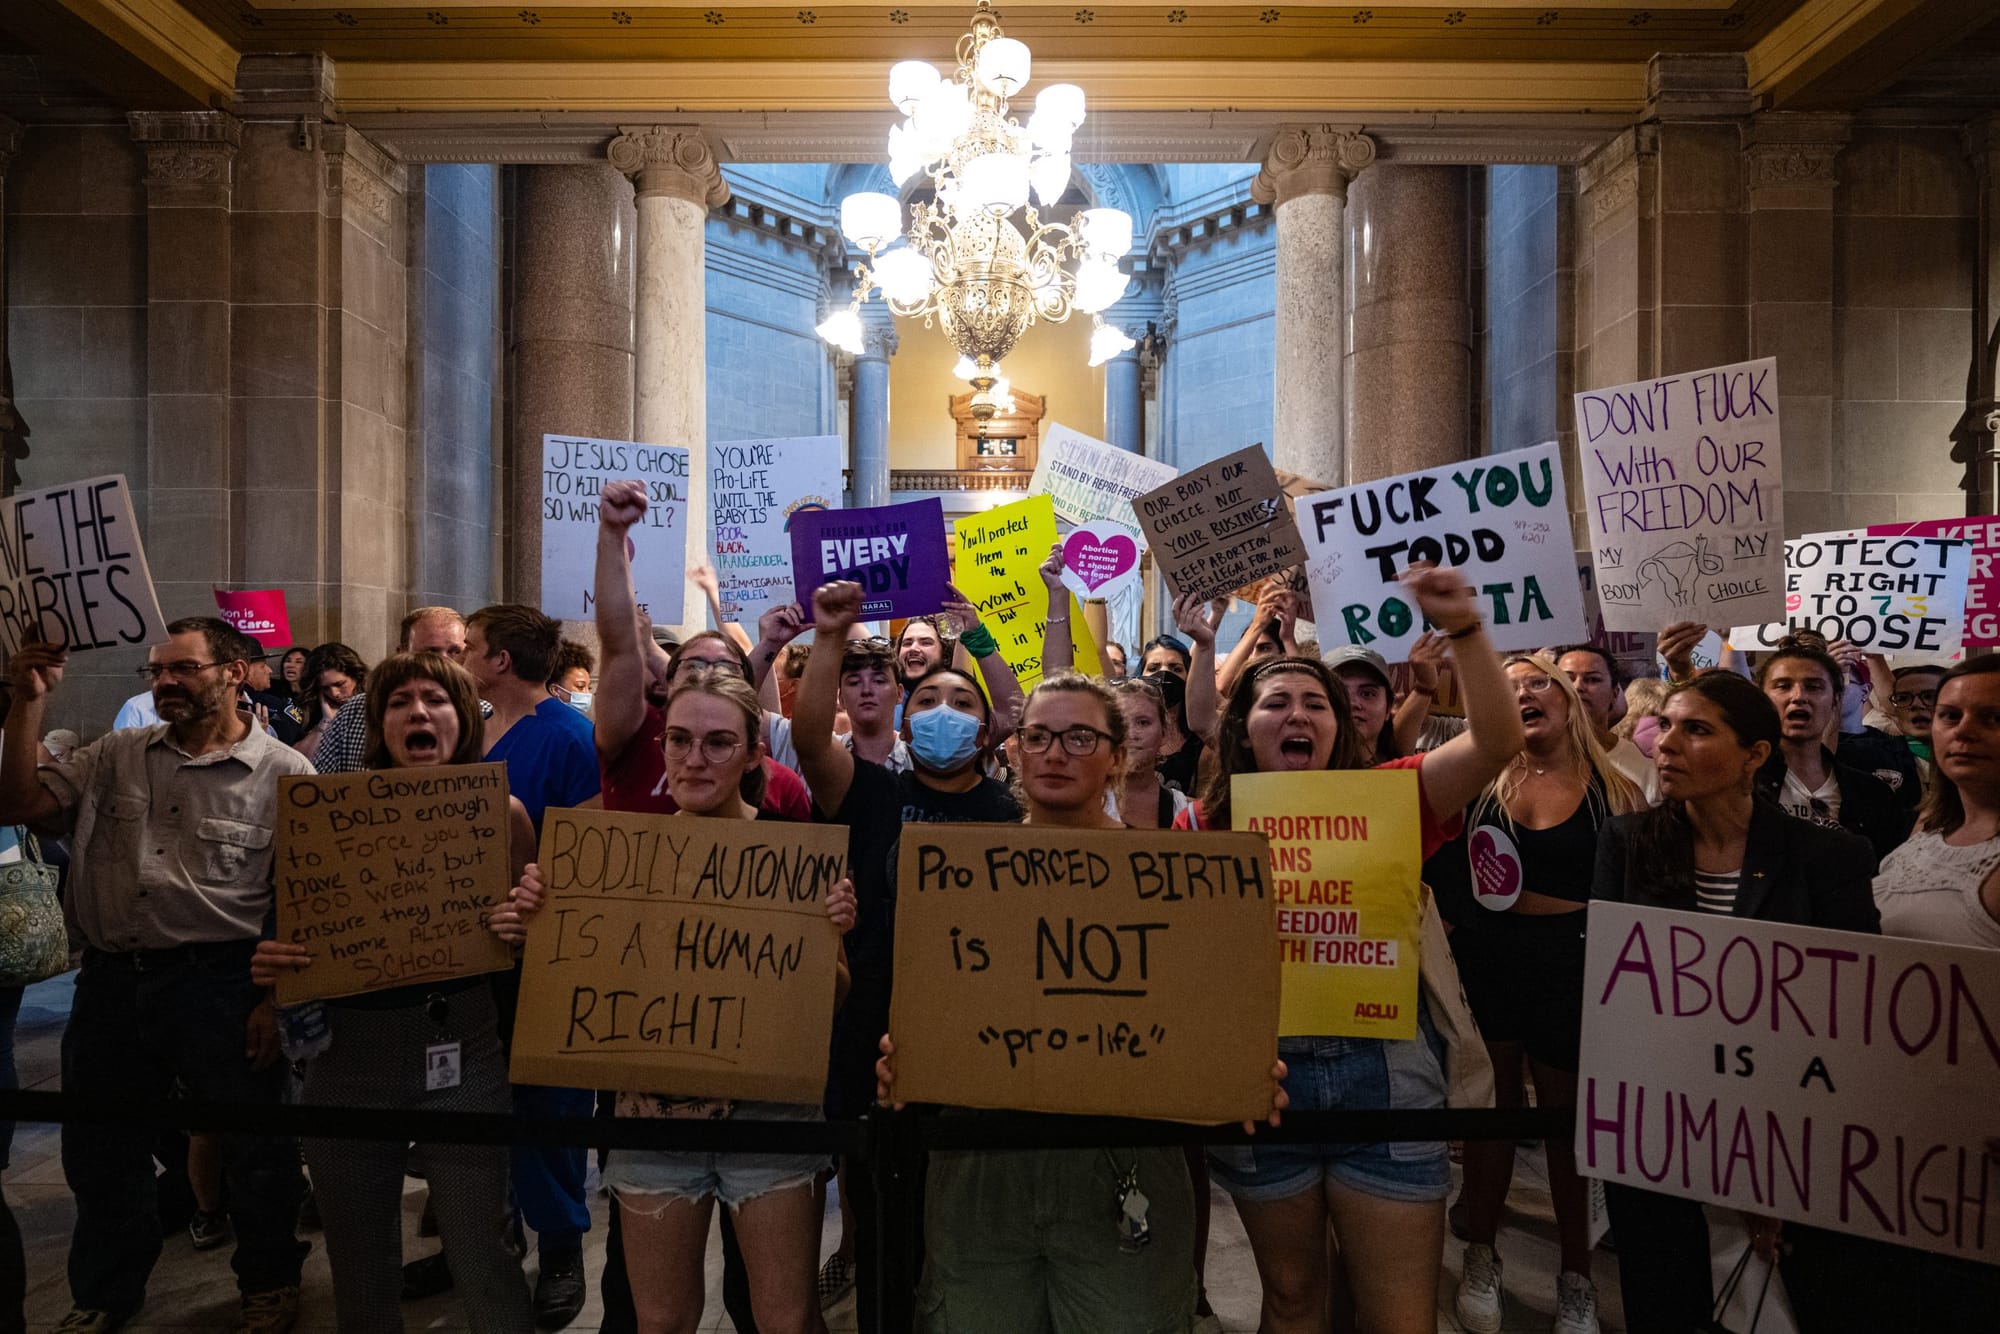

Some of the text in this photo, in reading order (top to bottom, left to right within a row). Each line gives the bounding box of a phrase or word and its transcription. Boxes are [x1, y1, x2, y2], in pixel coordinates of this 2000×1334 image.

[1582, 368, 1774, 443] DON'T FUCK
[550, 439, 689, 477] JESUS CHOSE
[1696, 435, 1767, 476] OUR
[543, 470, 571, 494] TO
[1050, 459, 1081, 481] STAND
[1079, 471, 1093, 485] BY
[1092, 476, 1117, 495] REPRO
[1143, 496, 1175, 517] OUR
[1222, 462, 1248, 482] OUR
[544, 498, 563, 520] SO
[714, 491, 753, 509] UNTIL
[754, 490, 778, 508] THE
[1067, 503, 1079, 516] BY
[1216, 487, 1243, 508] NOT
[1312, 457, 1552, 544] FUCK YOU
[1597, 478, 1763, 534] FREEDOM
[46, 480, 131, 568] THE
[714, 507, 769, 526] BABY IS
[988, 515, 1029, 543] protect
[820, 533, 909, 575] EVERY
[1081, 544, 1118, 555] Abortion
[1164, 530, 1209, 554] YOUR
[1734, 532, 1769, 556] MY
[1785, 539, 1963, 569] ROTECT
[975, 545, 1028, 567] them in
[1087, 562, 1116, 572] should
[1088, 554, 1119, 564] normal
[1170, 534, 1272, 586] KEEP ABORTION
[1250, 552, 1268, 568] FOR
[1365, 528, 1506, 583] TODD
[1600, 547, 1624, 564] MY
[989, 566, 1006, 577] the
[1078, 569, 1112, 580] be legal
[718, 579, 731, 590] AN
[1200, 575, 1248, 600] QUESTIONS
[1601, 582, 1642, 602] BODY
[1707, 577, 1767, 600] CHOICE
[1825, 573, 1946, 596] RIGHT
[244, 608, 254, 618] is
[861, 602, 890, 612] NARAL
[998, 608, 1017, 625] but
[1811, 594, 1857, 616] TO
[1871, 595, 1892, 616] 7
[1902, 596, 1928, 618] 3
[237, 619, 275, 631] Care.
[1013, 633, 1029, 645] in
[289, 769, 500, 809] Our Government
[290, 796, 489, 836] is BOLD enough
[1247, 816, 1368, 841] ABORTION
[288, 846, 322, 869] to
[422, 828, 459, 854] you
[468, 825, 496, 841] to
[550, 819, 691, 895] BODILY
[1269, 847, 1312, 872] ANS
[286, 873, 346, 900] have
[360, 868, 378, 885] a
[444, 850, 487, 872] but
[918, 845, 1264, 902] Pro FORCED BIRTH
[287, 876, 475, 921] TOO WEAK to
[291, 894, 500, 944] ensure they make
[330, 936, 389, 962] home
[409, 920, 473, 944] ALIVE
[547, 908, 804, 981] IS A HUMAN
[949, 916, 1170, 983] is NOT
[1313, 941, 1394, 966] FORCE.
[353, 949, 465, 982] SCHOOL
[1600, 920, 2000, 1068] ABORTION
[566, 986, 747, 1050] RIGHT!
[1354, 1003, 1398, 1020] ACLU
[1714, 1043, 1836, 1093] IS A
[1586, 1077, 1990, 1250] HUMAN RIGH
